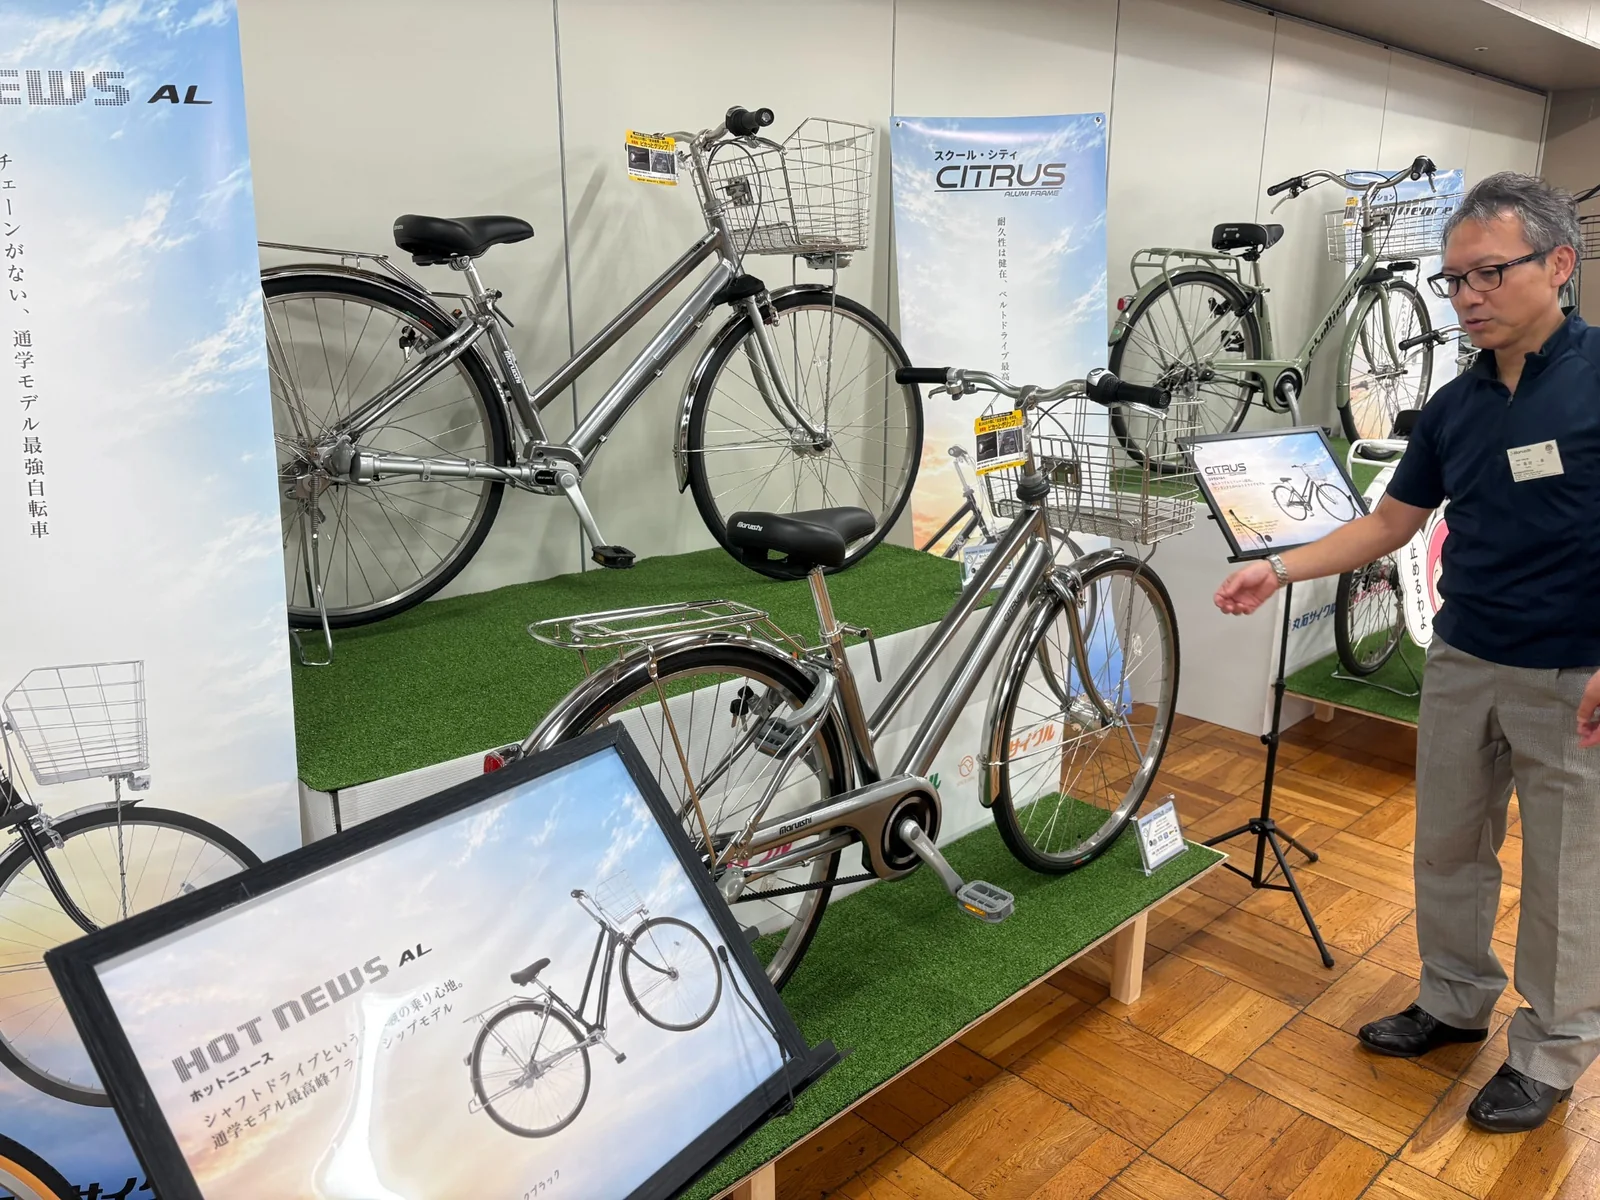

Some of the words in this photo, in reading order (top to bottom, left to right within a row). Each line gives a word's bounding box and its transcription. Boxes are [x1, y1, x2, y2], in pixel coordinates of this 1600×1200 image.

[147, 84, 213, 105] AL
[934, 149, 1018, 161] スクール・シティ
[936, 163, 1067, 188] CITRUS
[1004, 190, 1029, 198] ALUMI
[1030, 189, 1060, 197] FRAME
[0, 153, 49, 539] チェーンがない、通学モデル最強自転車
[1204, 463, 1247, 475] CITRUS
[1409, 542, 1428, 631] 止めるわよ
[171, 1016, 263, 1083] HOT
[398, 943, 433, 968] AL
[190, 1051, 274, 1103] ホットニュース
